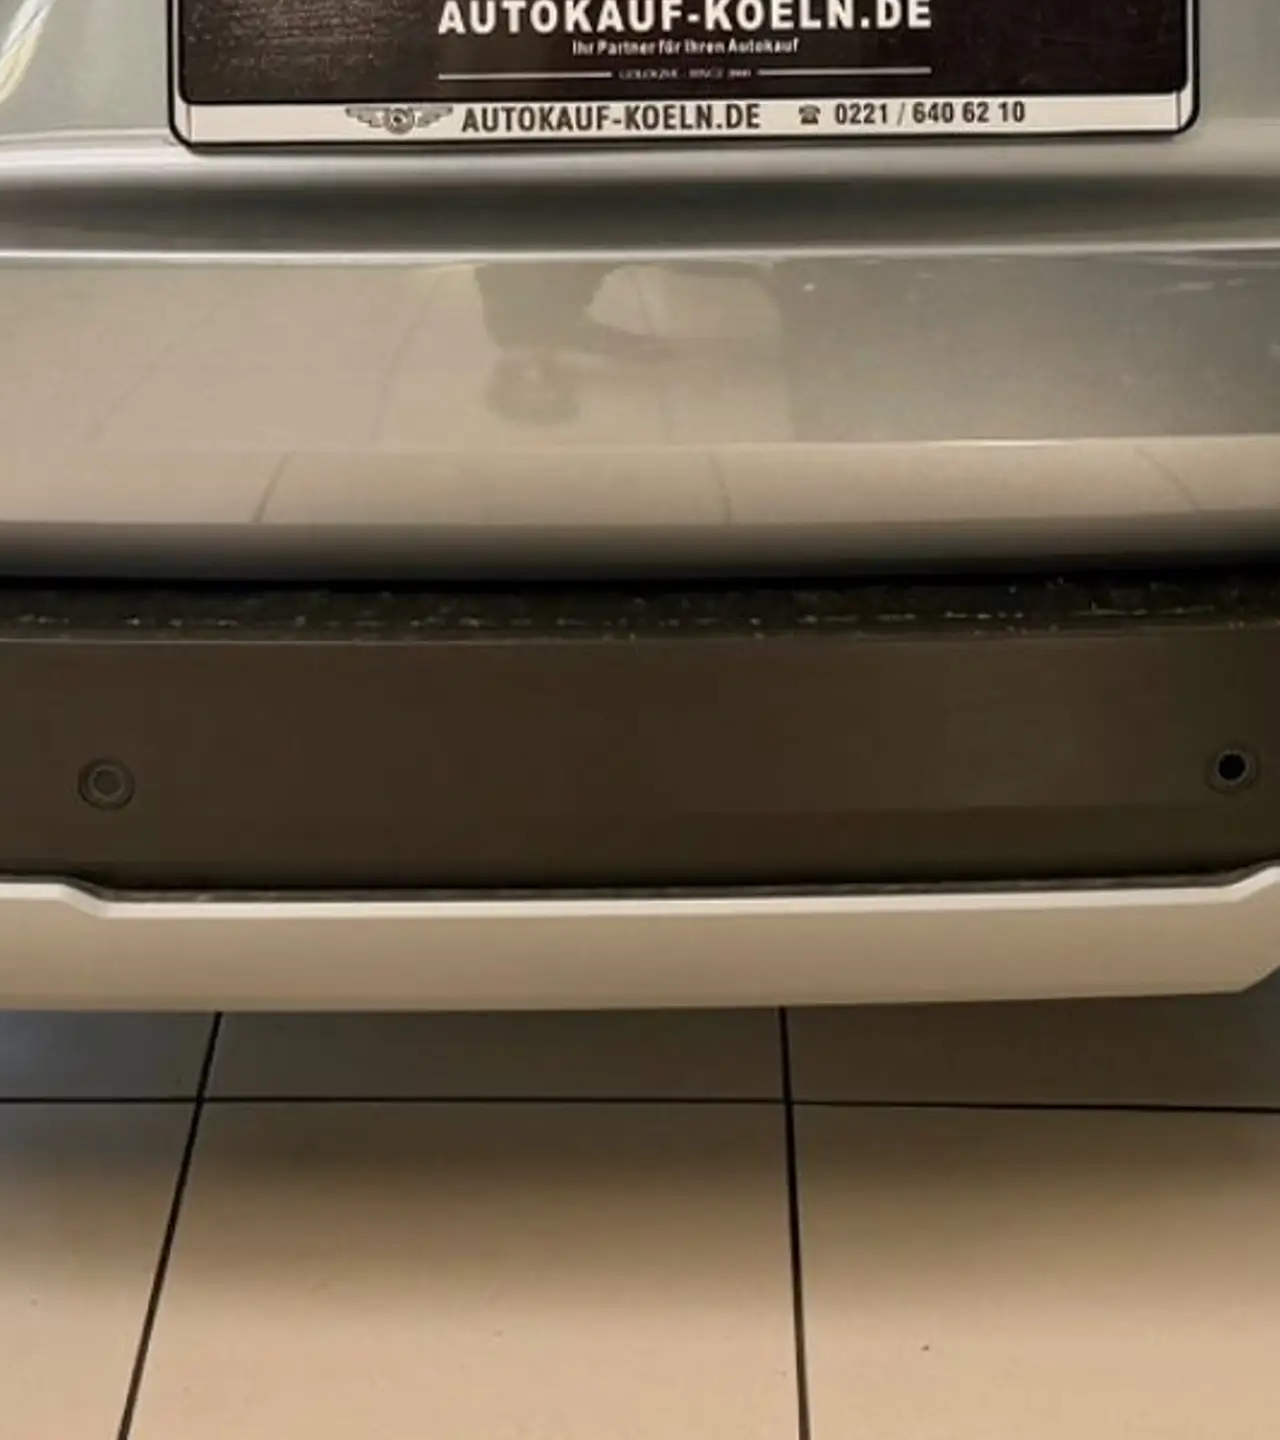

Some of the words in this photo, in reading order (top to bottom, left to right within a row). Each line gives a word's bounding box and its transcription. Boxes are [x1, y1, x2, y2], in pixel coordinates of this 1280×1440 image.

[572, 40, 594, 55] Ihr
[597, 39, 655, 56] Partner
[658, 38, 681, 55] für
[684, 37, 725, 55] Ihren
[728, 37, 799, 54] Autokauf
[462, 103, 761, 133] AUTOKAUF-KOELN.DE
[834, 104, 888, 125] 0221
[896, 102, 906, 126] /
[912, 102, 954, 124] 640
[961, 101, 989, 123] 62
[998, 101, 1025, 123] 10
